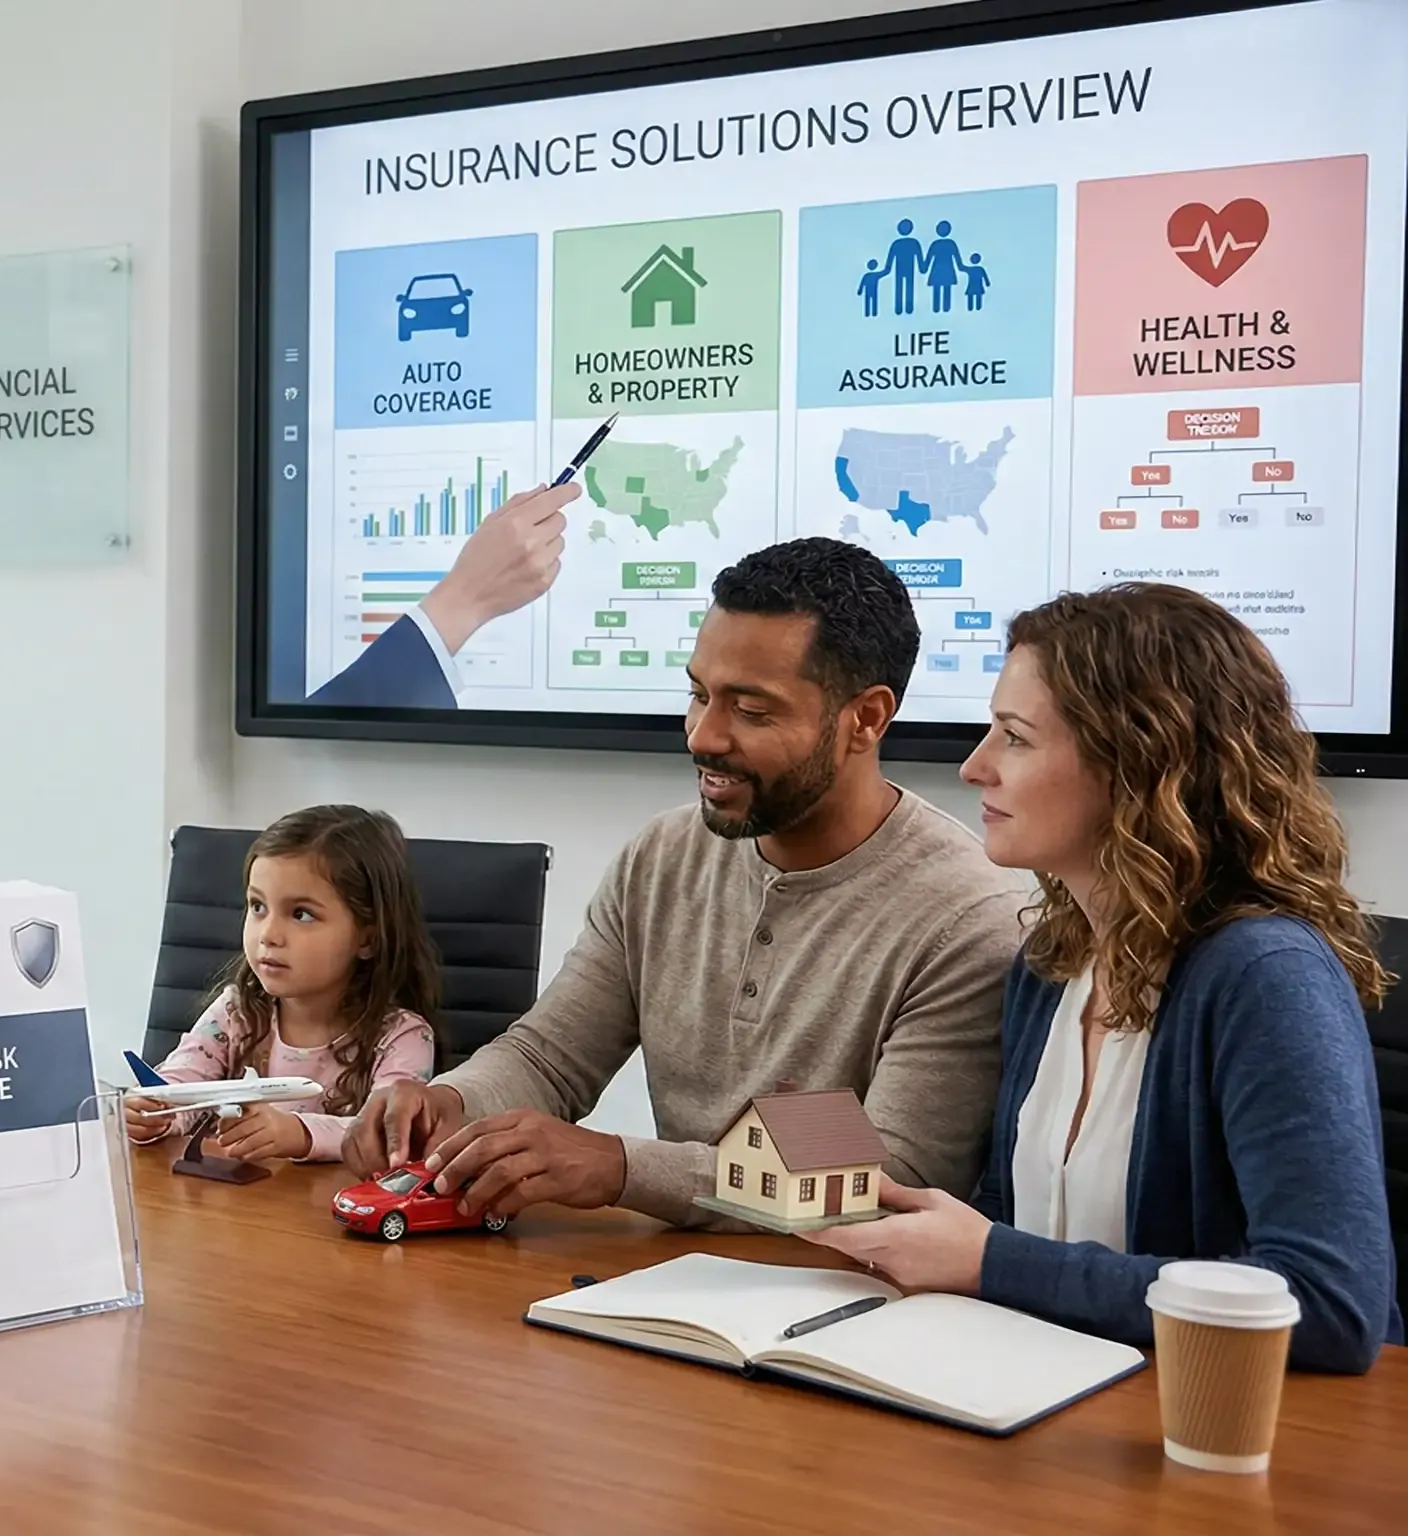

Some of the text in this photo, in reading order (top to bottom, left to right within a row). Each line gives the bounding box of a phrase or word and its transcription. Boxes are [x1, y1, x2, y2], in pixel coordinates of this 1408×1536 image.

[367, 67, 1152, 195] INSURANCE SOLUTIONS OVERVIEW
[1142, 310, 1289, 342] HEALTH &
[895, 331, 949, 356] LIFE
[576, 344, 753, 375] HOMEOWNERS
[1134, 345, 1295, 376] WELLNESS
[403, 361, 461, 384] AUTO
[839, 361, 1006, 391] ASSURANCE
[374, 388, 491, 414] COVERAGE
[589, 376, 739, 403] & PROPERTY
[1141, 471, 1161, 481] Yes
[1265, 466, 1283, 477] No
[1172, 514, 1188, 525] No
[1228, 513, 1249, 524] Yes
[1296, 512, 1313, 522] No
